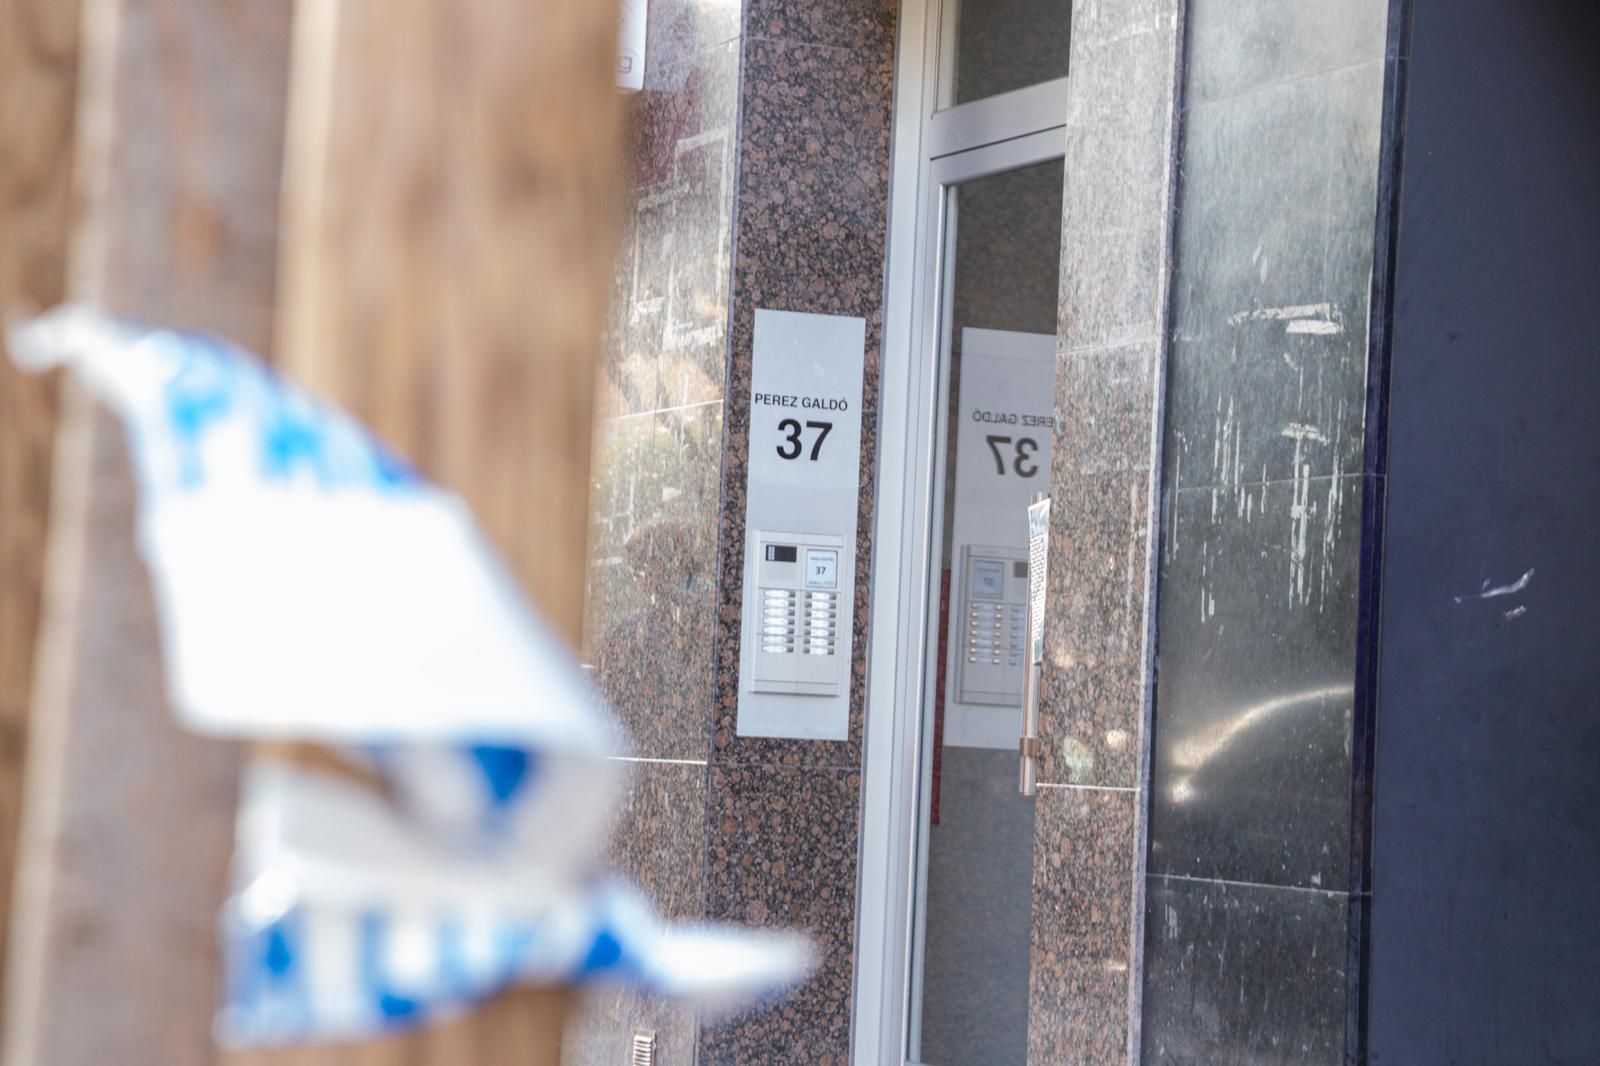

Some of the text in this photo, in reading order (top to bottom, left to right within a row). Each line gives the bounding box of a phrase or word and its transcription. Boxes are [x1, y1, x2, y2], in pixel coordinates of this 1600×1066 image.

[754, 393, 848, 411] PEREZ GALDÓ
[776, 418, 833, 462] 37
[815, 566, 826, 575] 37
